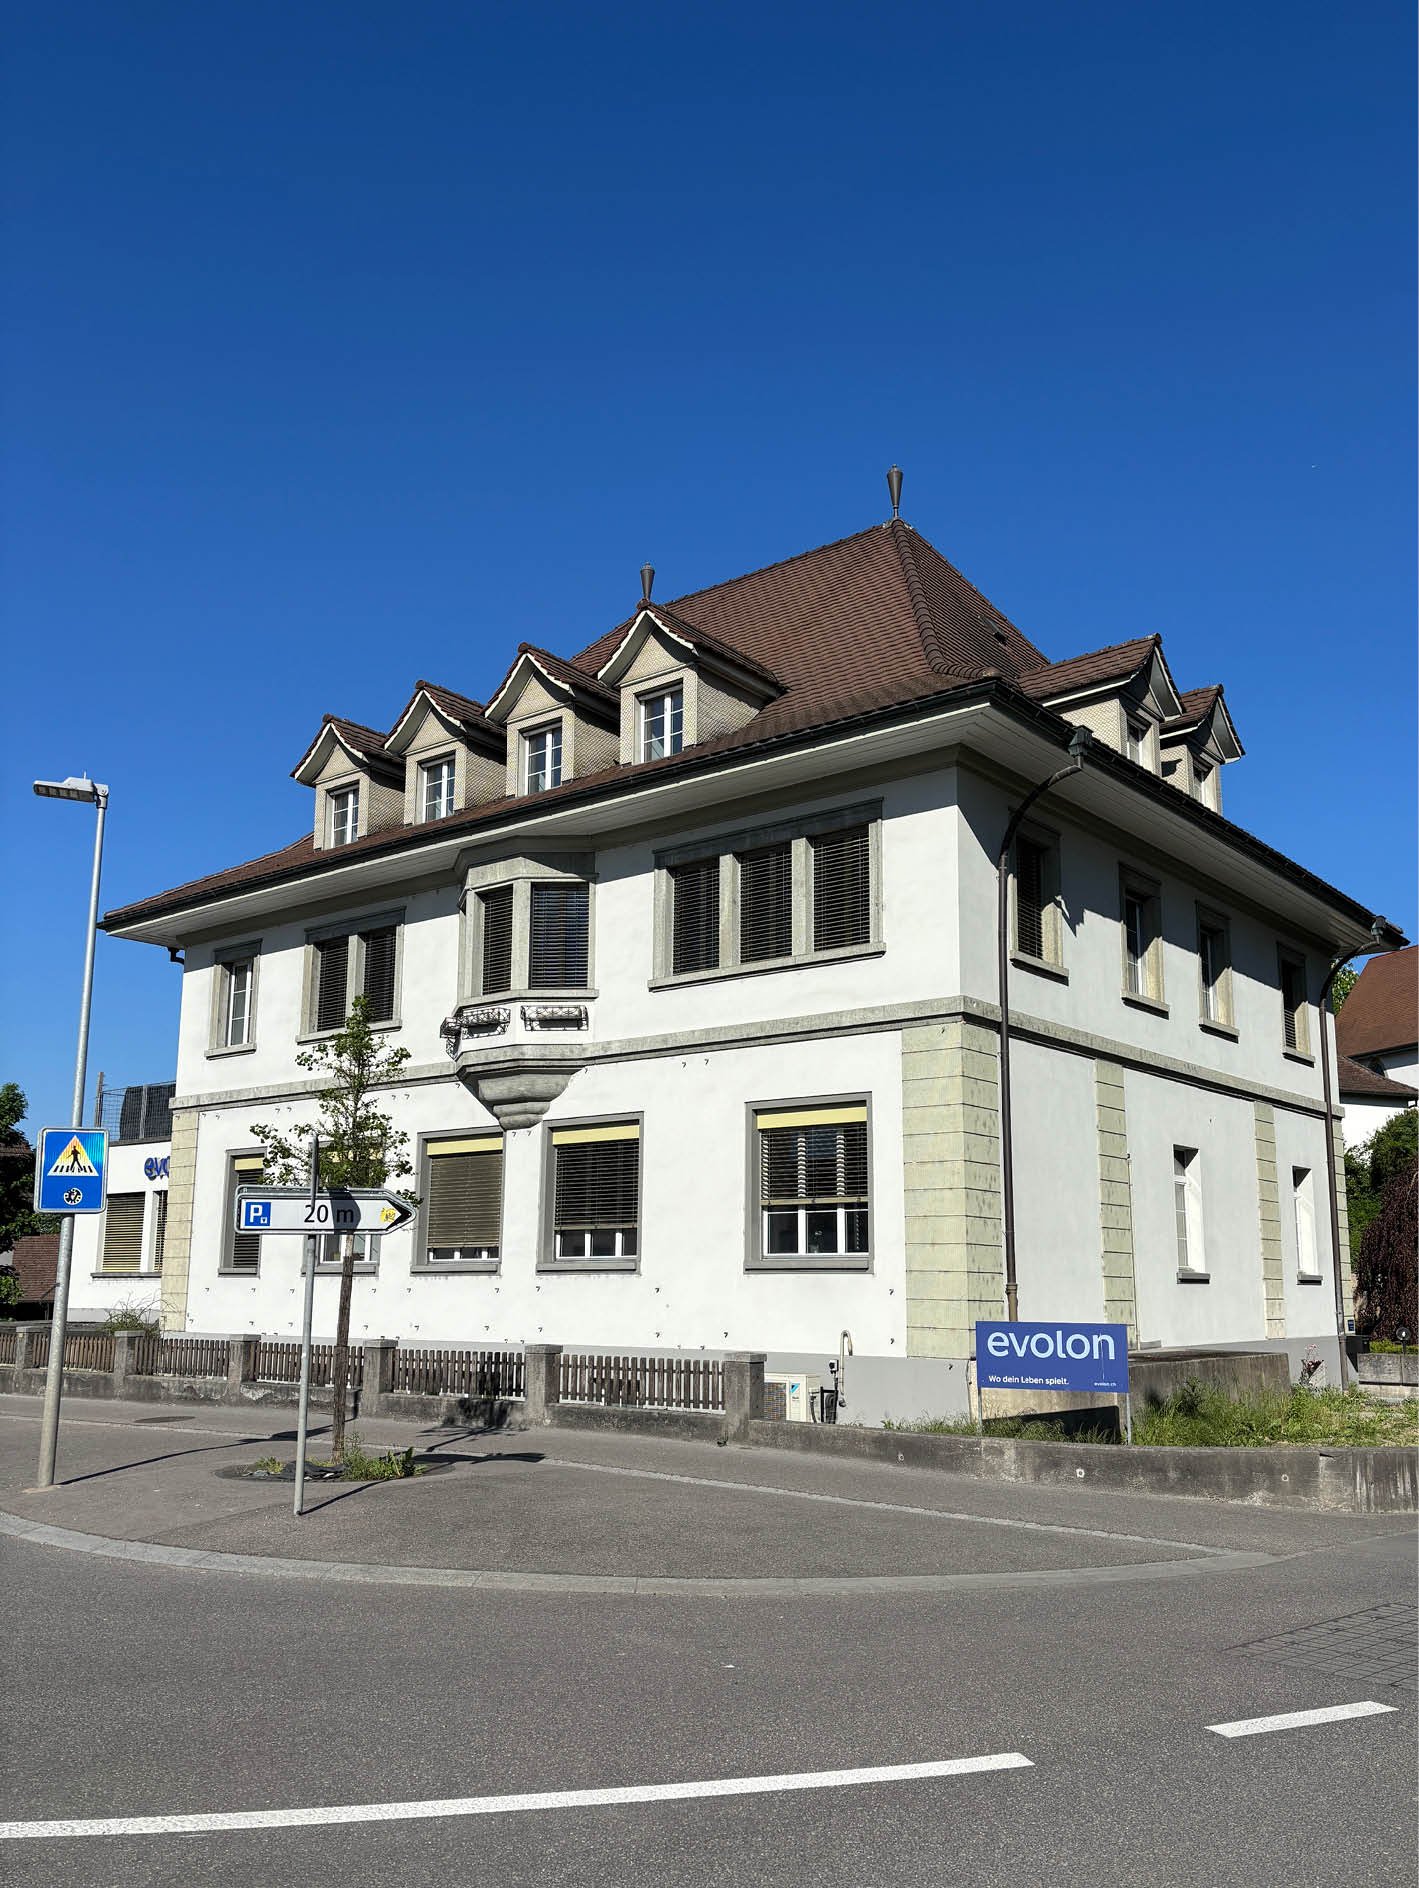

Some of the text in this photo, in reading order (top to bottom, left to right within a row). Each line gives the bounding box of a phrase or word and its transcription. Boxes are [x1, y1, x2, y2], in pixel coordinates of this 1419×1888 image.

[250, 1204, 263, 1223] P
[304, 1204, 354, 1223] 20 m
[987, 1330, 1115, 1360] evolon
[988, 1375, 1069, 1386] Wo dein Leben spielt.
